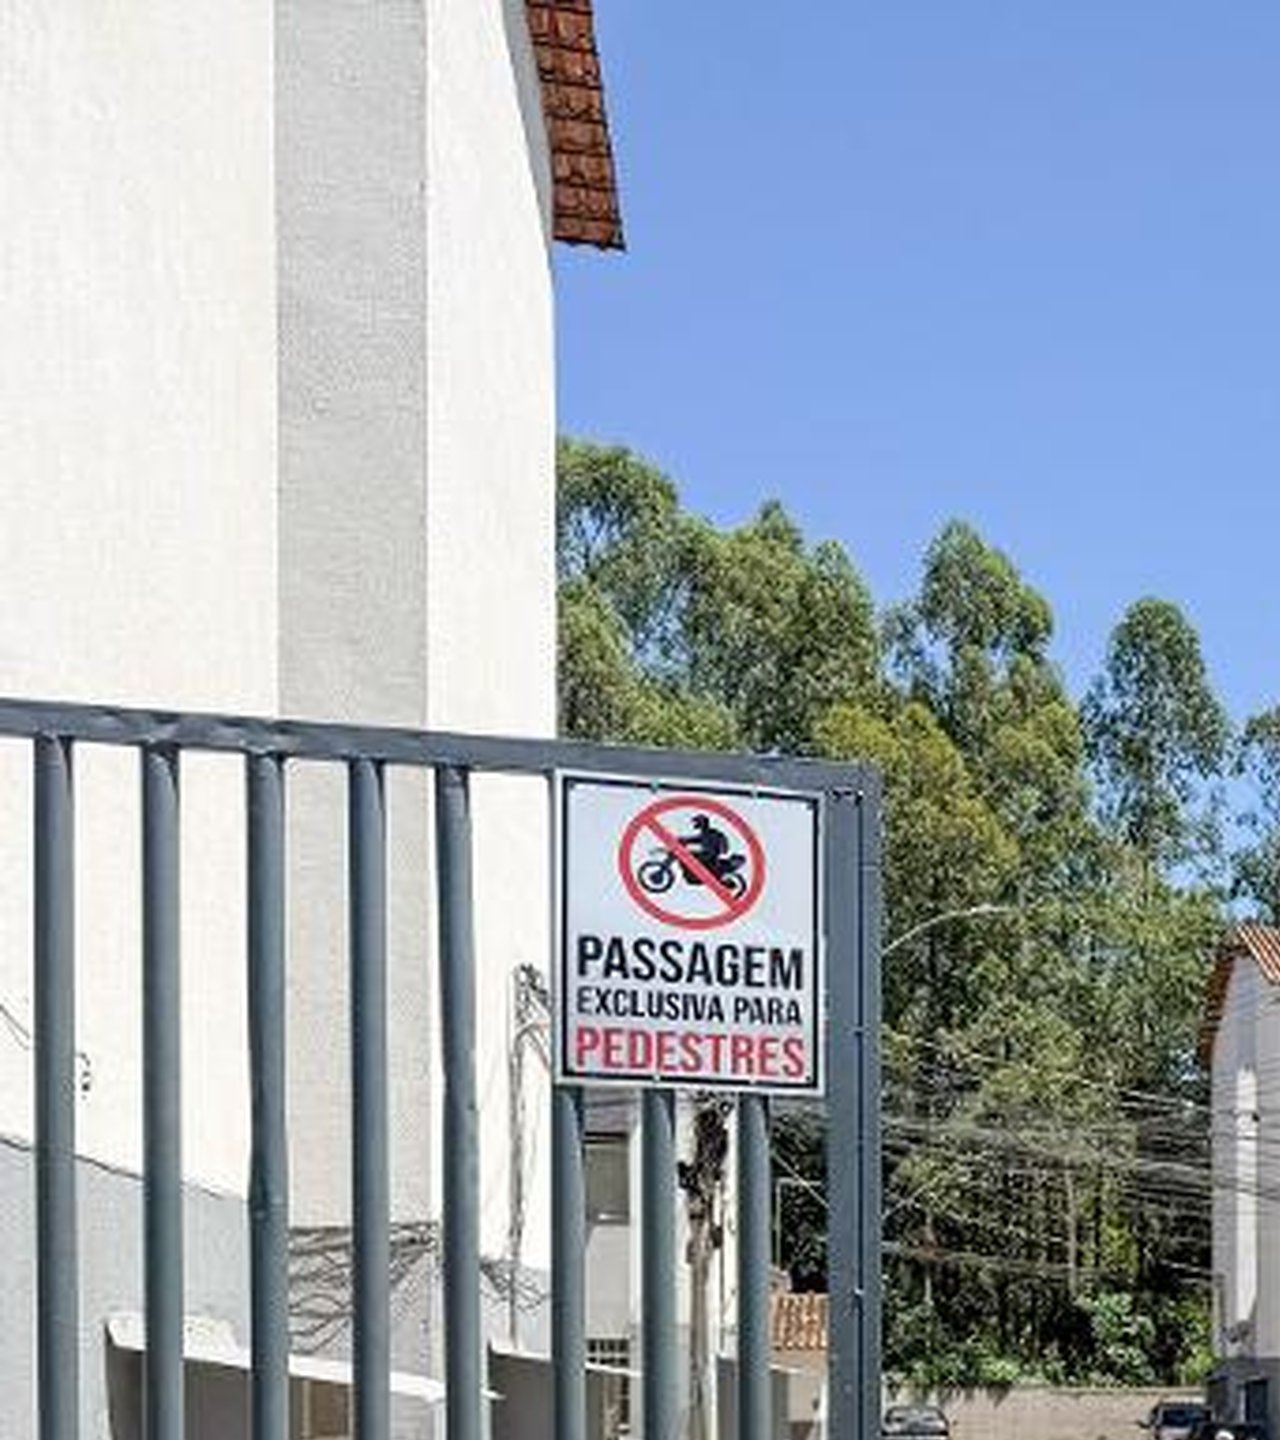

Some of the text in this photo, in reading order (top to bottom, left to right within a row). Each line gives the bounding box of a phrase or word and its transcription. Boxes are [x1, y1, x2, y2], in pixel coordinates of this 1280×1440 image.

[576, 936, 803, 990] PASSAGEM
[576, 986, 803, 1025] EXCLUSIVA PARA
[575, 1026, 805, 1077] PEDESTRES
